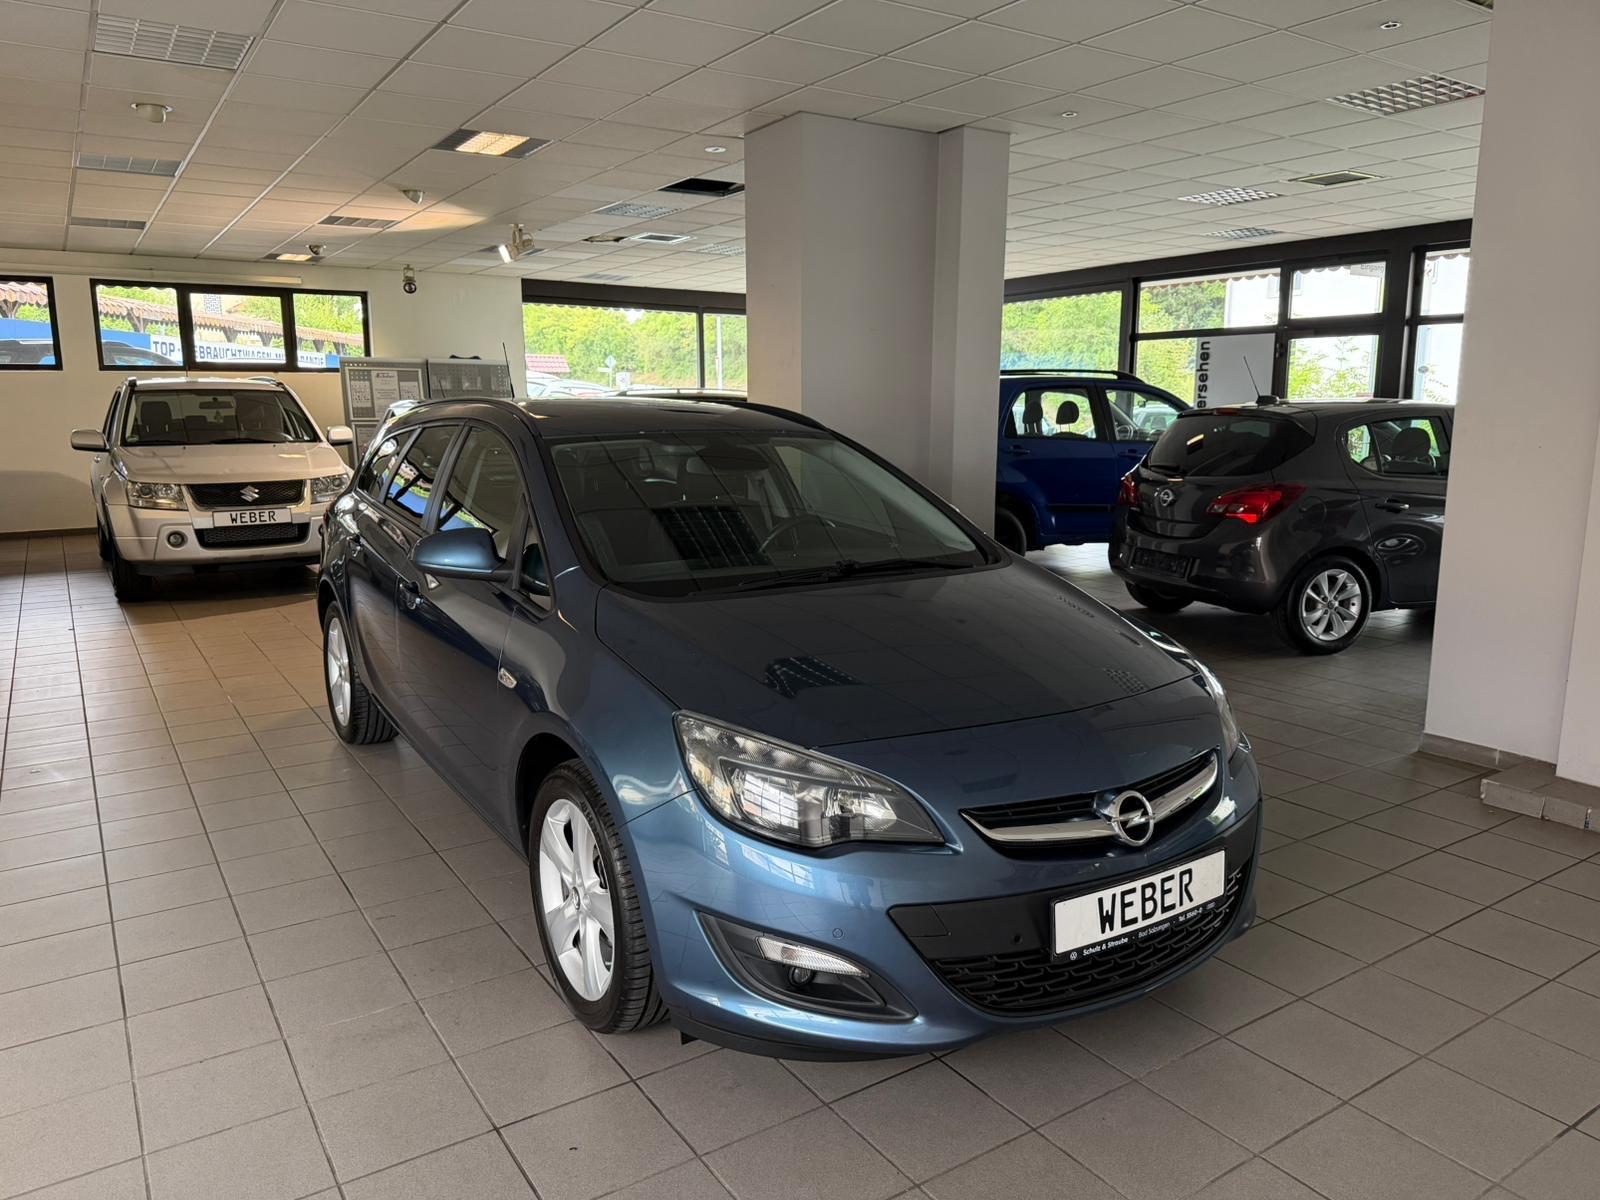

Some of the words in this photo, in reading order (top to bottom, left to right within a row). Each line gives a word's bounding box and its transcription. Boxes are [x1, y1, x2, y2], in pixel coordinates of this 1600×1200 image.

[1196, 341, 1211, 409] ersehen
[229, 510, 277, 525] WEBER
[1097, 867, 1194, 935] WEBER
